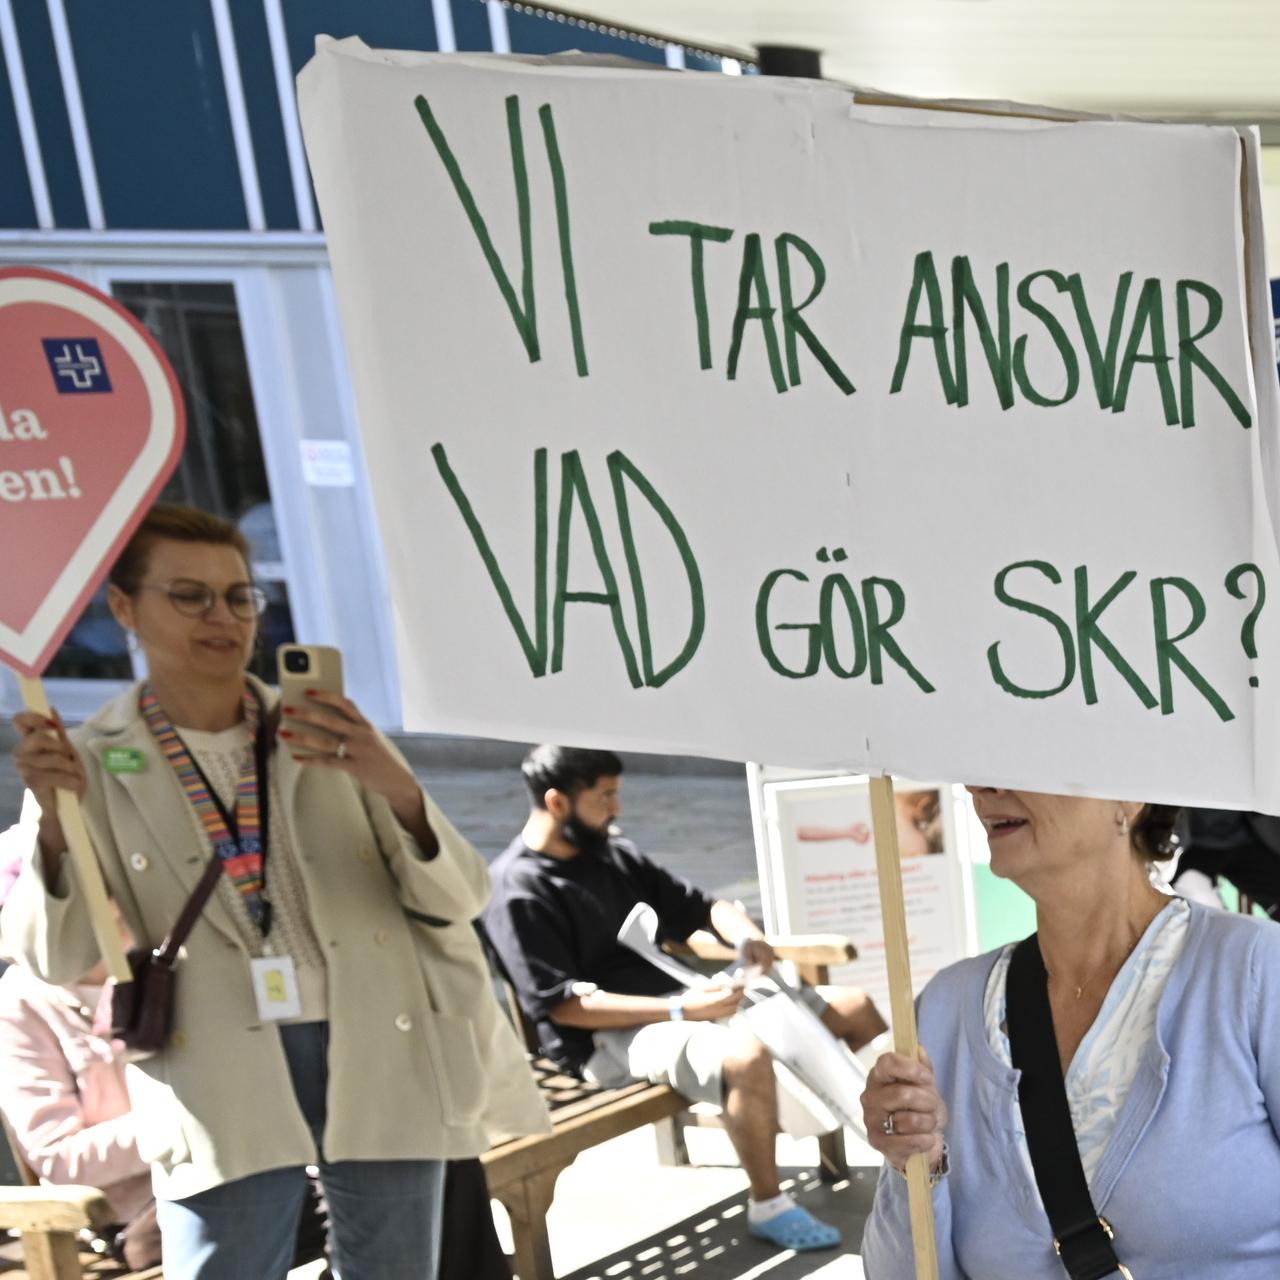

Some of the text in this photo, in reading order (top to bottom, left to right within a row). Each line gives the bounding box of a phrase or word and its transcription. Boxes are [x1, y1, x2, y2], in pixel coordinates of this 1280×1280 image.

[414, 94, 1252, 428] VI TAR ANSVAR
[430, 442, 1267, 722] VAD GÖR SKR?
